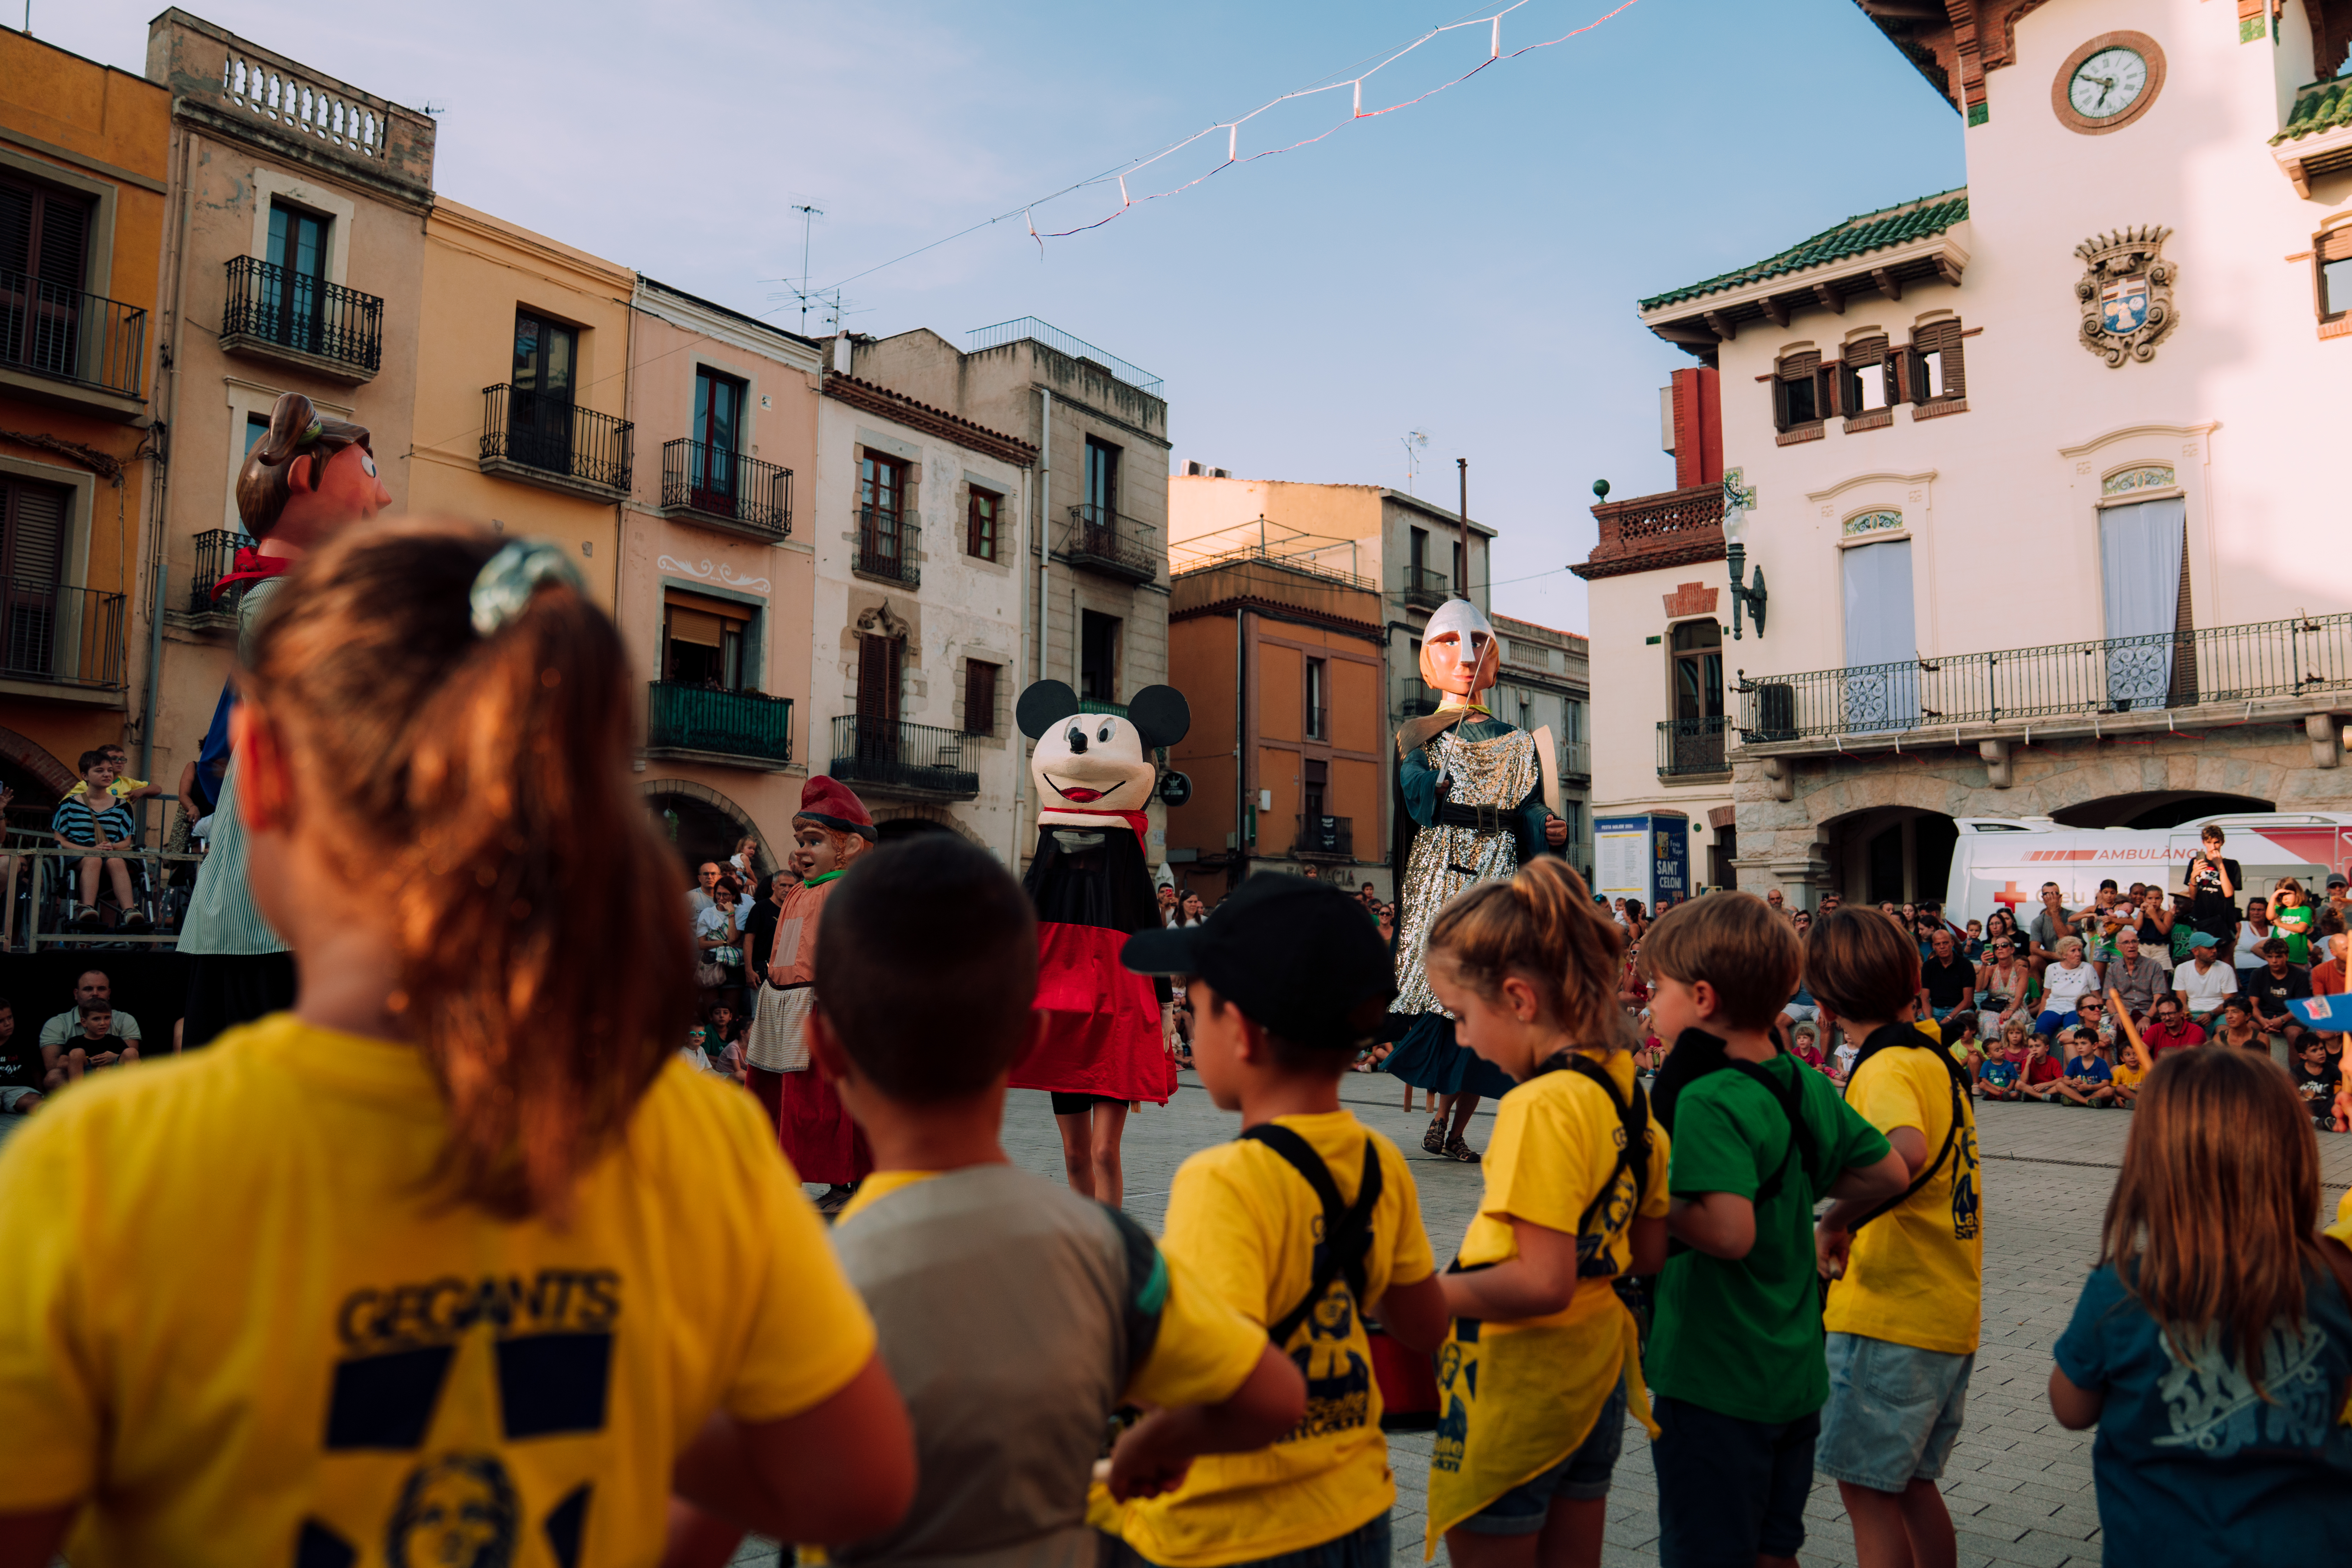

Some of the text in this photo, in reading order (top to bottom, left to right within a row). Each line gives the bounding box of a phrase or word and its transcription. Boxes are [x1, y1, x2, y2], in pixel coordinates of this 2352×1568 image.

[1672, 847, 1684, 856] Major
[2098, 846, 2203, 859] AMBULÀNC
[1657, 860, 1678, 875] SANT
[1286, 866, 1355, 886] FAMACIA
[1659, 876, 1682, 889] CELONI
[336, 1270, 619, 1346] GEGANTS
